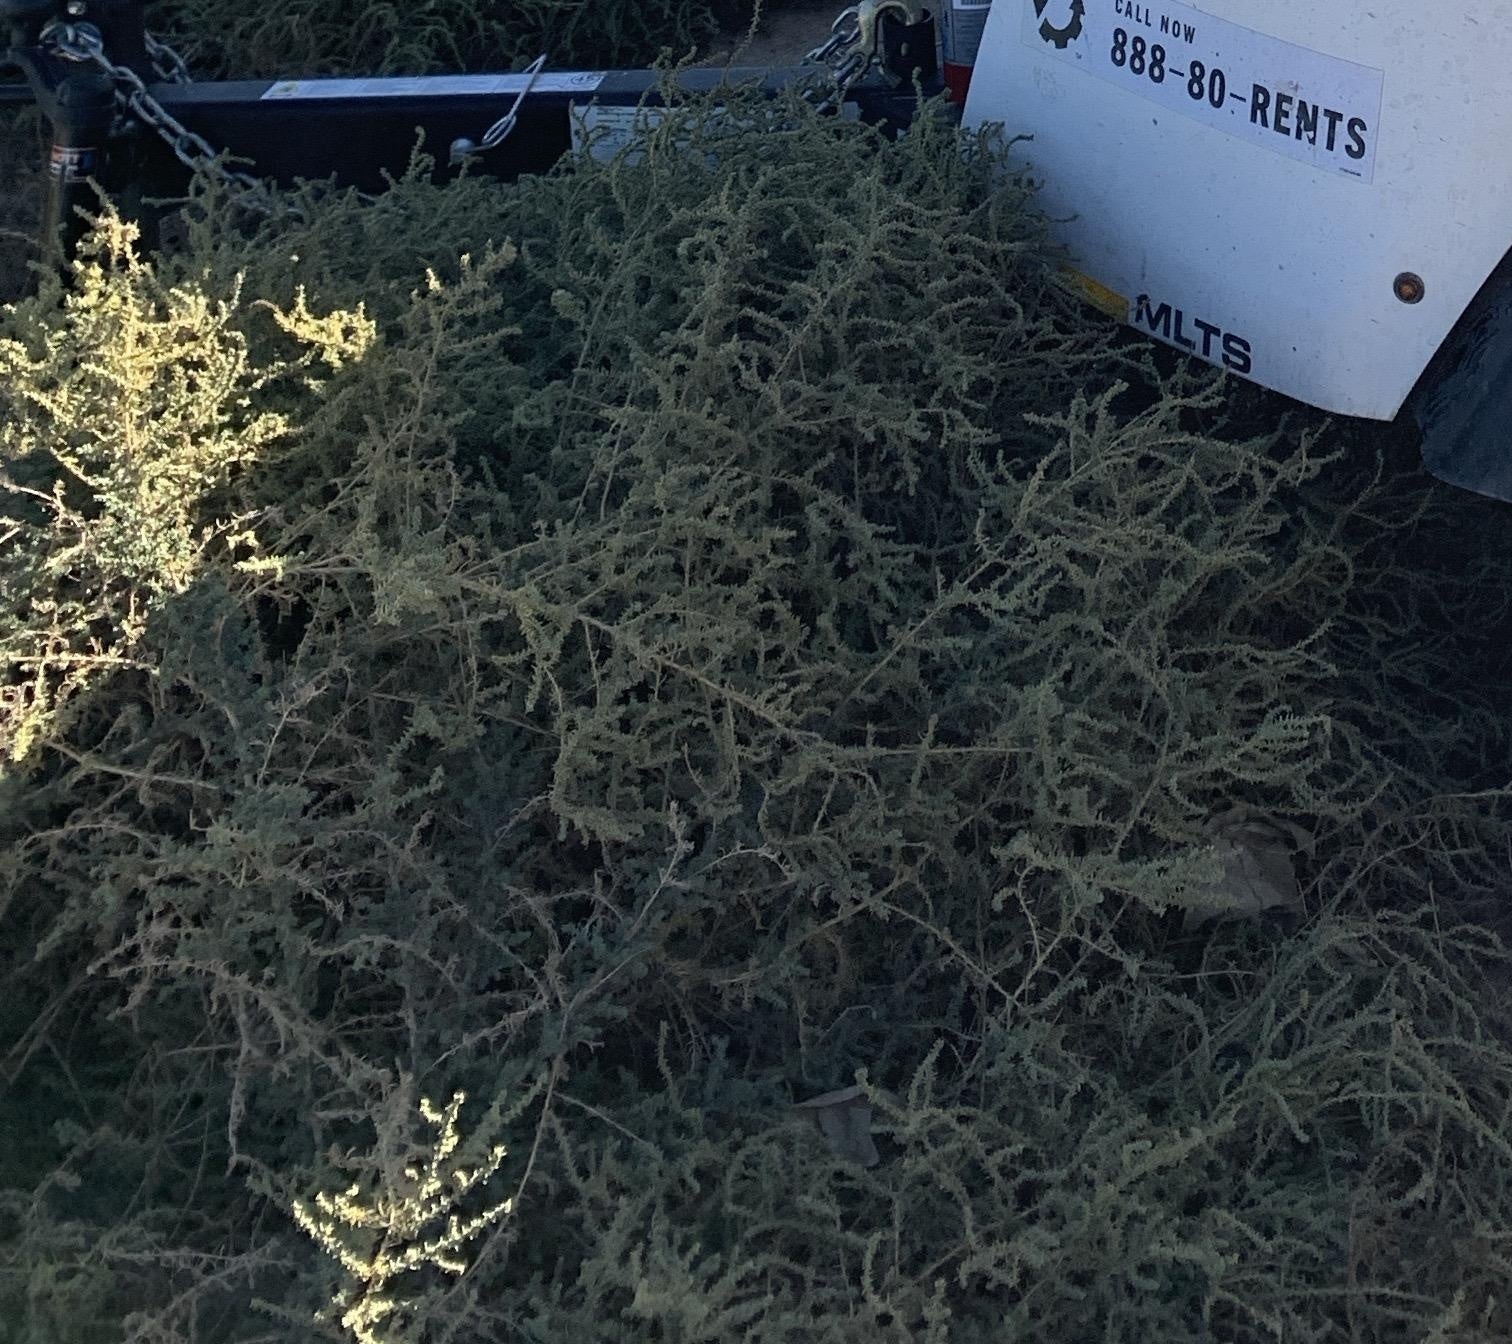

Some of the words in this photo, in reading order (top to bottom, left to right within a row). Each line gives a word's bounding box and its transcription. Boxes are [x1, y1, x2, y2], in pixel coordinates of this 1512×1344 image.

[1159, 14, 1197, 45] NOW
[1110, 27, 1368, 160] 888-80-RENTS
[1134, 293, 1252, 375] MLTS
